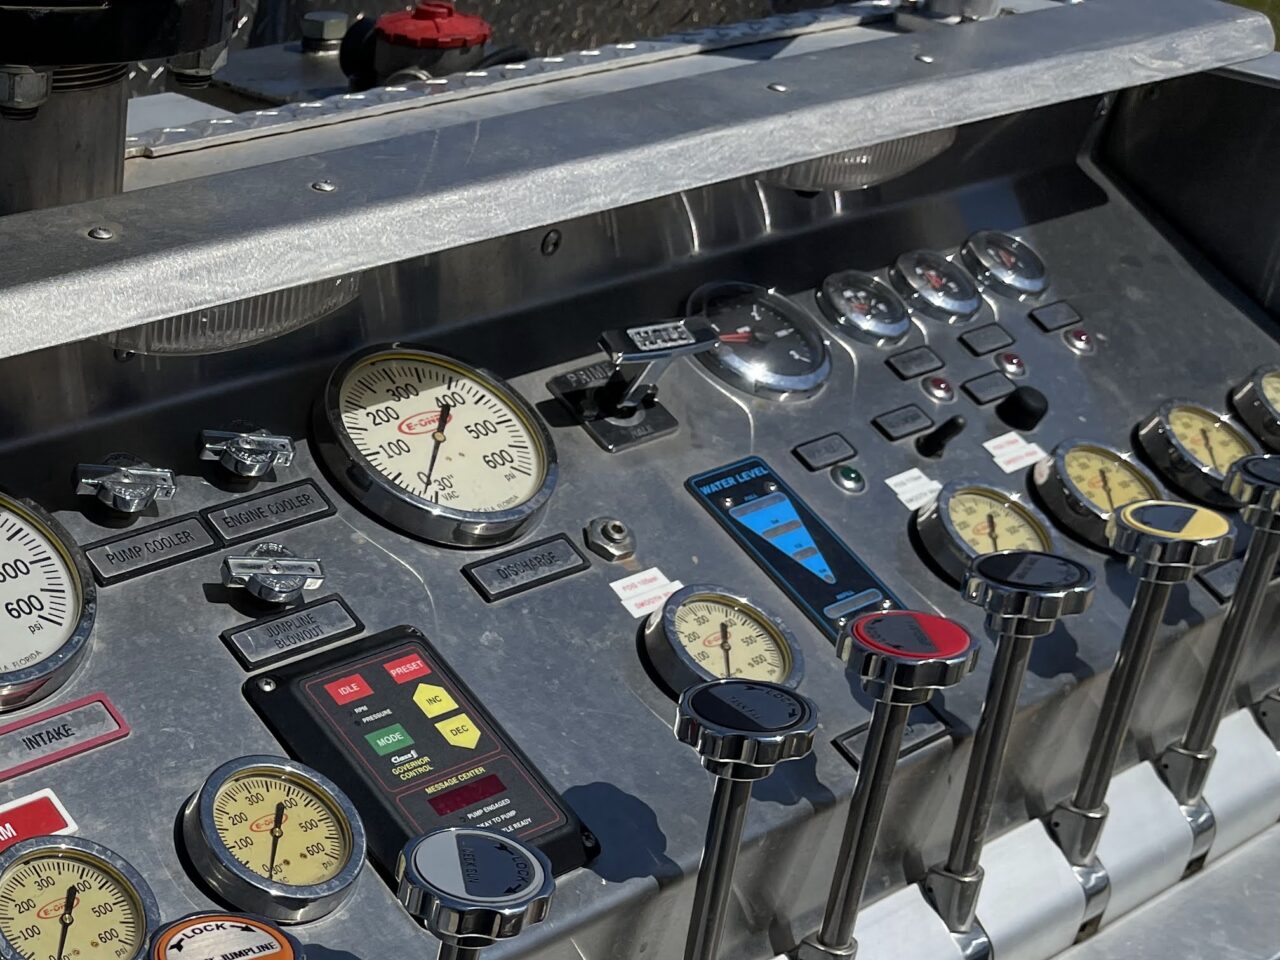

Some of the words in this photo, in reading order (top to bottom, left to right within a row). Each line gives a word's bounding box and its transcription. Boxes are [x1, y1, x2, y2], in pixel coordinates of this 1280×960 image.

[386, 383, 420, 402] 300
[435, 391, 466, 408] 400
[366, 406, 400, 426] 200
[465, 420, 498, 440] 500
[378, 439, 411, 459] 100
[483, 449, 514, 469] 600
[417, 471, 432, 486] 0
[699, 476, 736, 496] WATER
[737, 466, 769, 482] LEVEL
[442, 490, 460, 502] VAC
[222, 506, 266, 529] ENGINE
[269, 493, 315, 516] COOLER
[106, 545, 143, 565] PUMP
[145, 530, 196, 555] COOLER
[496, 551, 560, 580] DISCHARGE
[5, 594, 44, 619] 600
[28, 621, 44, 635] psi
[267, 613, 317, 638] JUMPLINE
[274, 625, 325, 649] BLOWOUT
[12, 650, 42, 668] FLORIDA
[390, 660, 424, 677] PRESET
[338, 683, 360, 696] IDLE
[426, 695, 443, 706] INC
[362, 709, 393, 724] PRESSURE
[22, 724, 75, 751] INTAKE
[450, 724, 469, 737] DEC
[376, 731, 404, 748] MODE
[392, 756, 431, 775] GOVERNOR
[399, 765, 434, 781] CONTROL
[424, 776, 458, 794] MESSAGE
[458, 766, 486, 783] CENTER
[247, 793, 264, 806] 300
[467, 809, 483, 819] PUMP
[483, 798, 511, 813] ENGAGED
[500, 810, 517, 820] PUMP
[229, 812, 248, 826] 200
[299, 819, 318, 832] 500
[235, 836, 254, 850] 100
[306, 843, 325, 856] 600
[34, 875, 56, 891] 300
[14, 898, 36, 914] 200
[91, 902, 113, 918] 500
[19, 925, 41, 940] 100
[98, 928, 119, 944] 600
[183, 923, 227, 940] LOCK
[115, 947, 128, 959] psi
